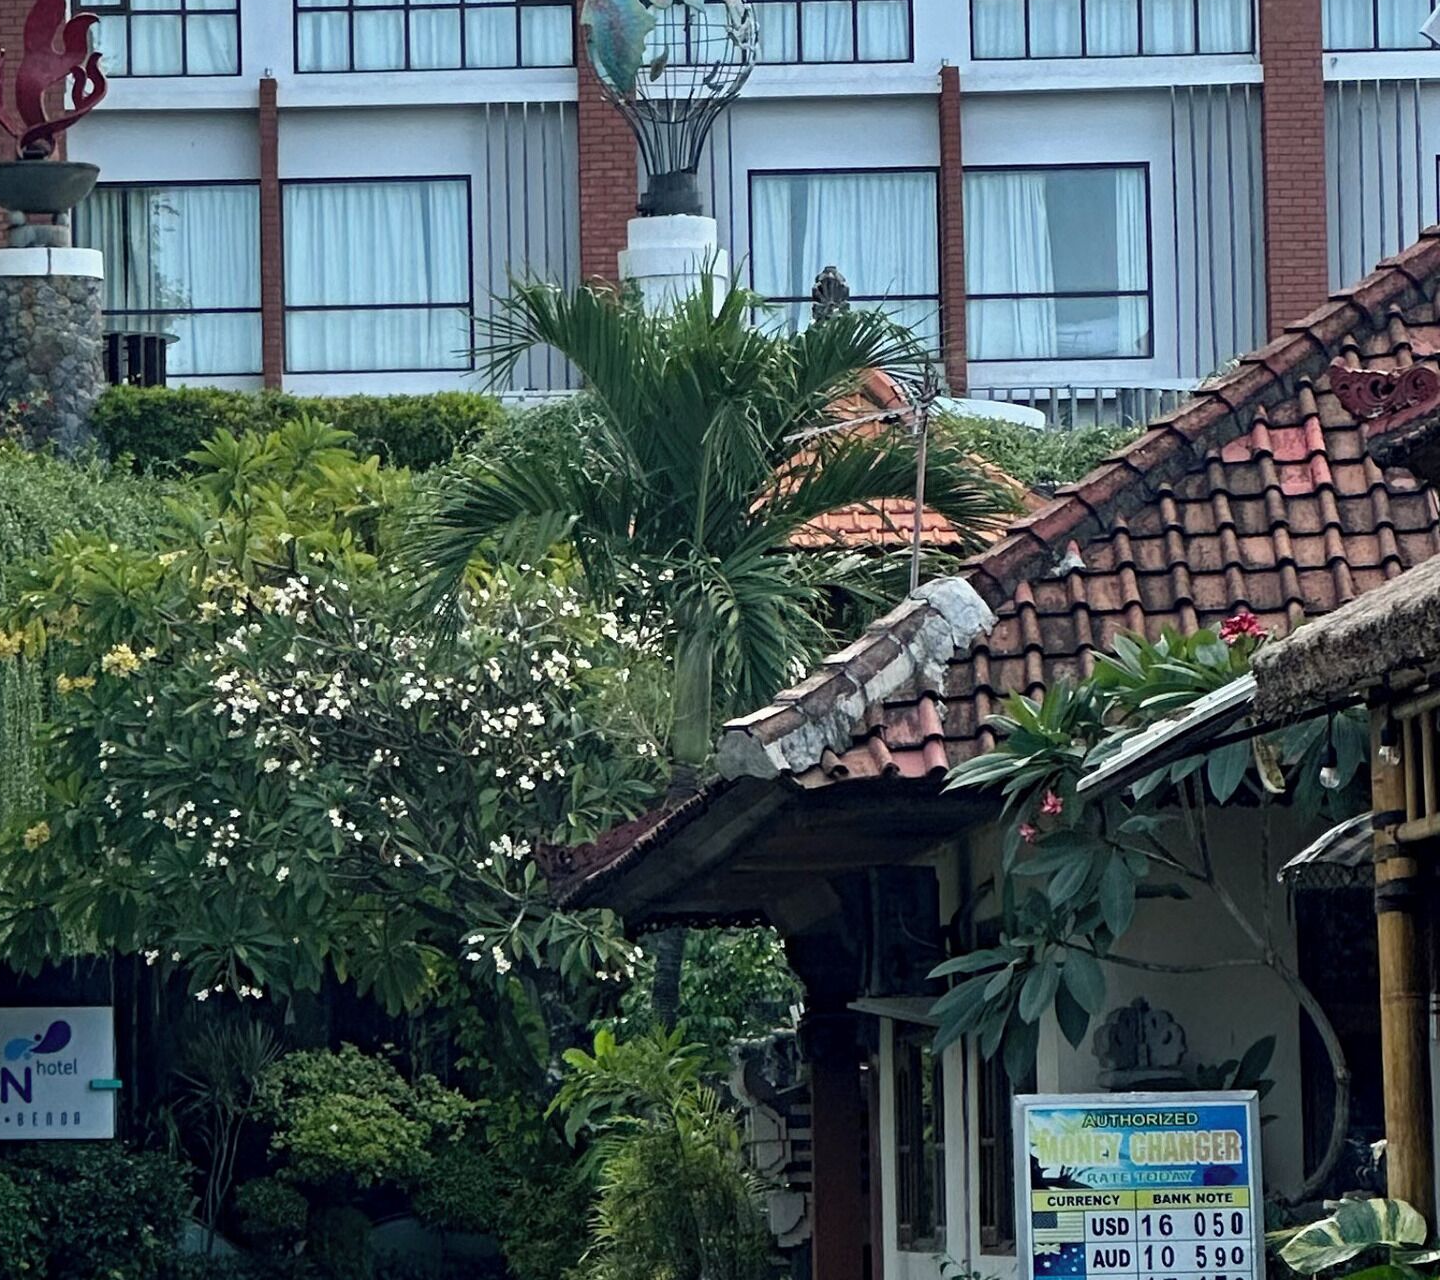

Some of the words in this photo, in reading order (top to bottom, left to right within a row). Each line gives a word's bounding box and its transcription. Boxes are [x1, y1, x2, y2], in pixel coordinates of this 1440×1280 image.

[36, 1058, 78, 1076] hotel
[1082, 1112, 1199, 1129] AUTHORIZED
[1038, 1131, 1122, 1165] MONEY
[1130, 1130, 1243, 1165] CHANGER
[1087, 1172, 1129, 1184] RATE
[1136, 1170, 1194, 1183] TODAY
[1047, 1195, 1120, 1207] CURRENCY
[1152, 1193, 1192, 1205] BANK
[1196, 1192, 1233, 1204] NOTE
[1091, 1217, 1130, 1236] USD
[1092, 1249, 1131, 1268] AUD
